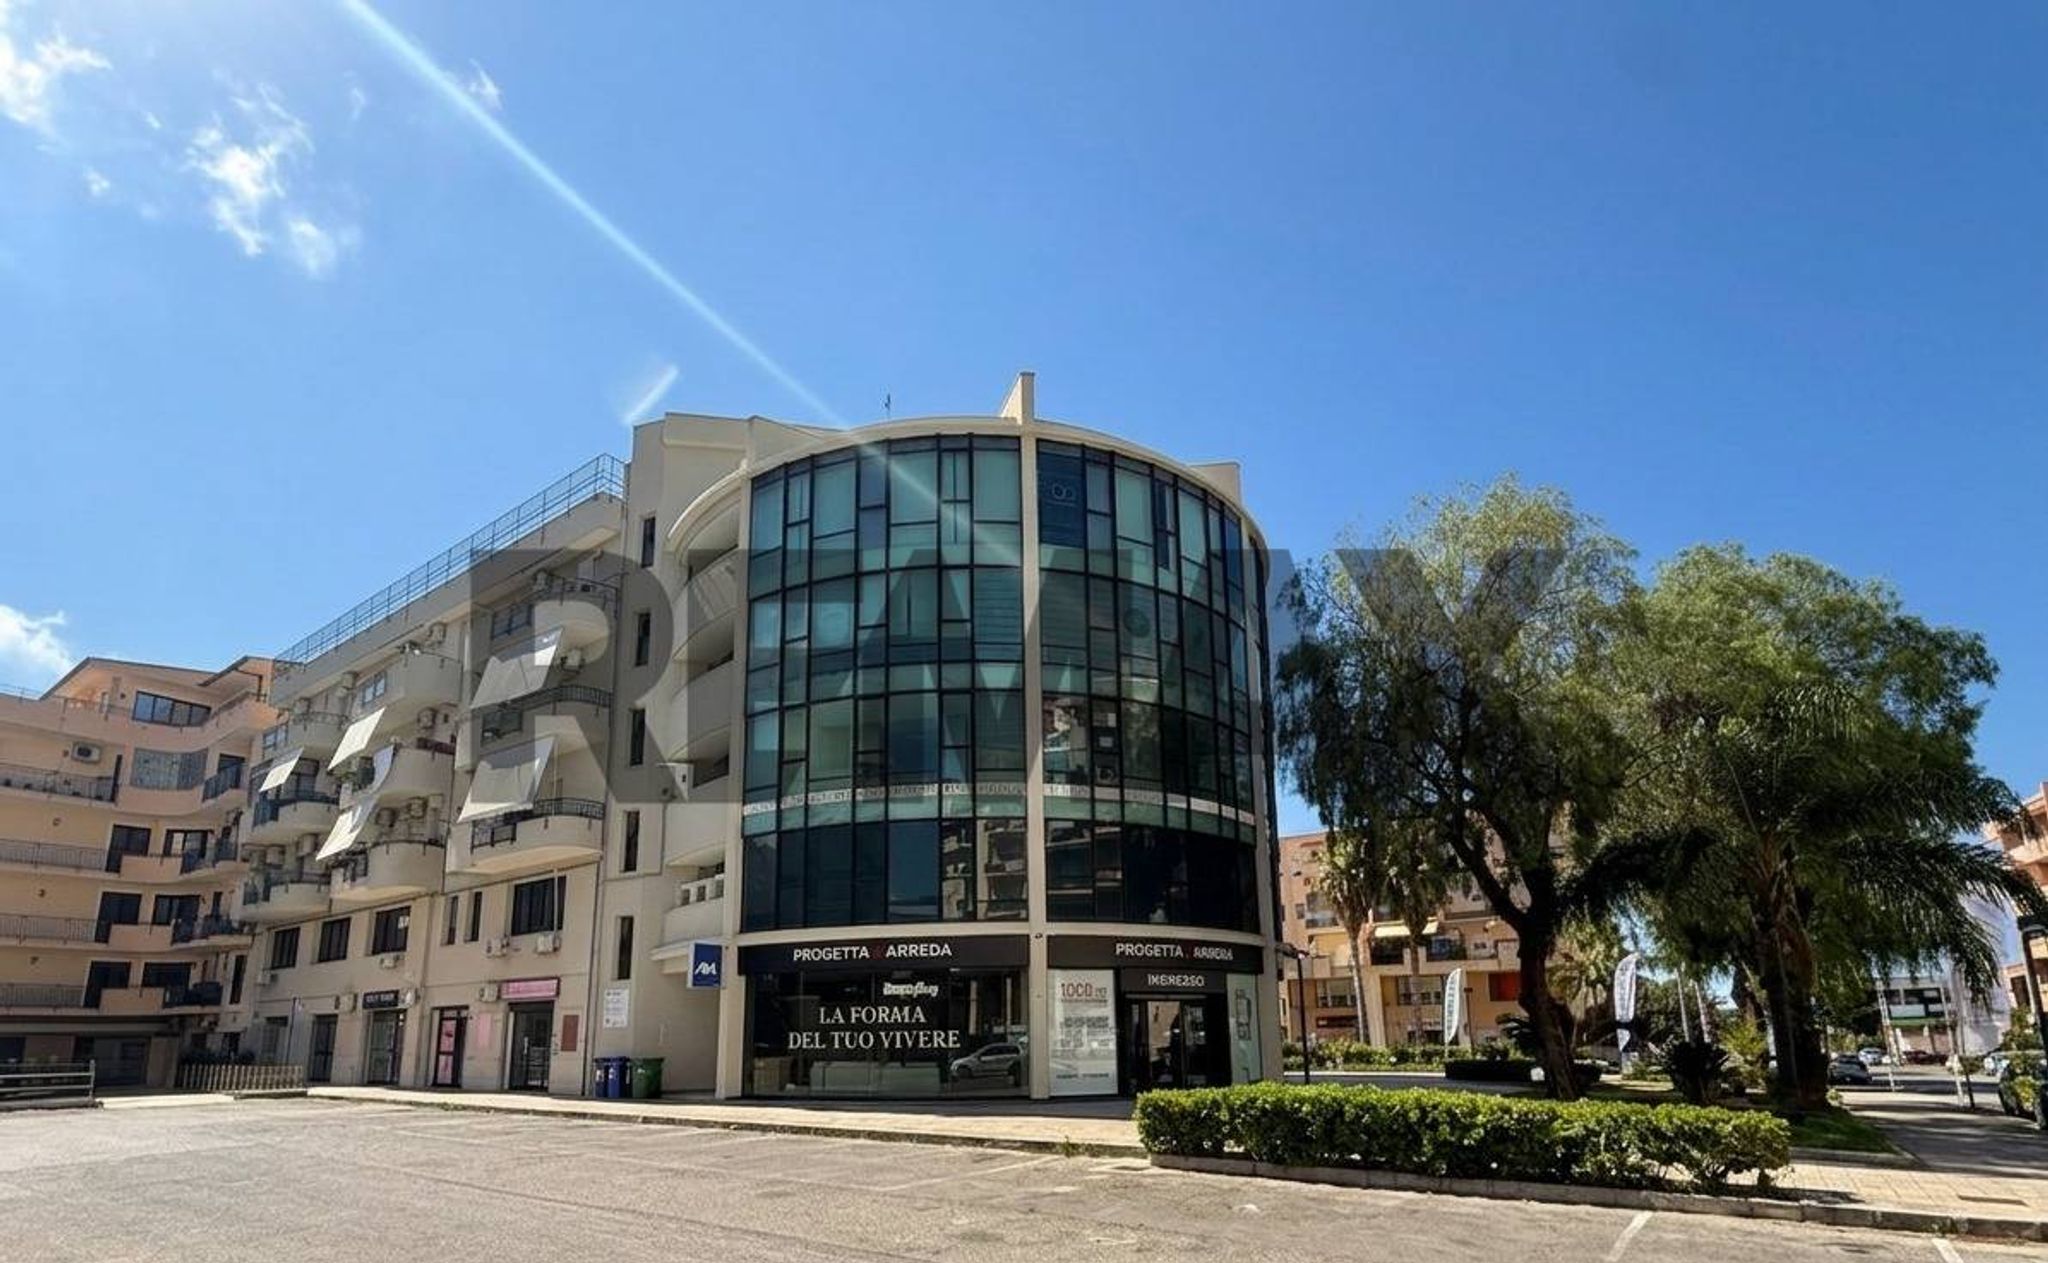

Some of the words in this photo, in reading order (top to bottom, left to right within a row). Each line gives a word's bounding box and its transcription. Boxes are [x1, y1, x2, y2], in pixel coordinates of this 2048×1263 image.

[793, 946, 870, 961] PROGETTA
[885, 943, 952, 957] ARREDA
[1115, 943, 1183, 958] PROGETTA
[819, 1007, 845, 1024] LA
[850, 1006, 926, 1024] FORMA
[788, 1031, 826, 1049] DEL
[830, 1031, 874, 1049] TUO
[879, 1030, 961, 1049] VIVERE
